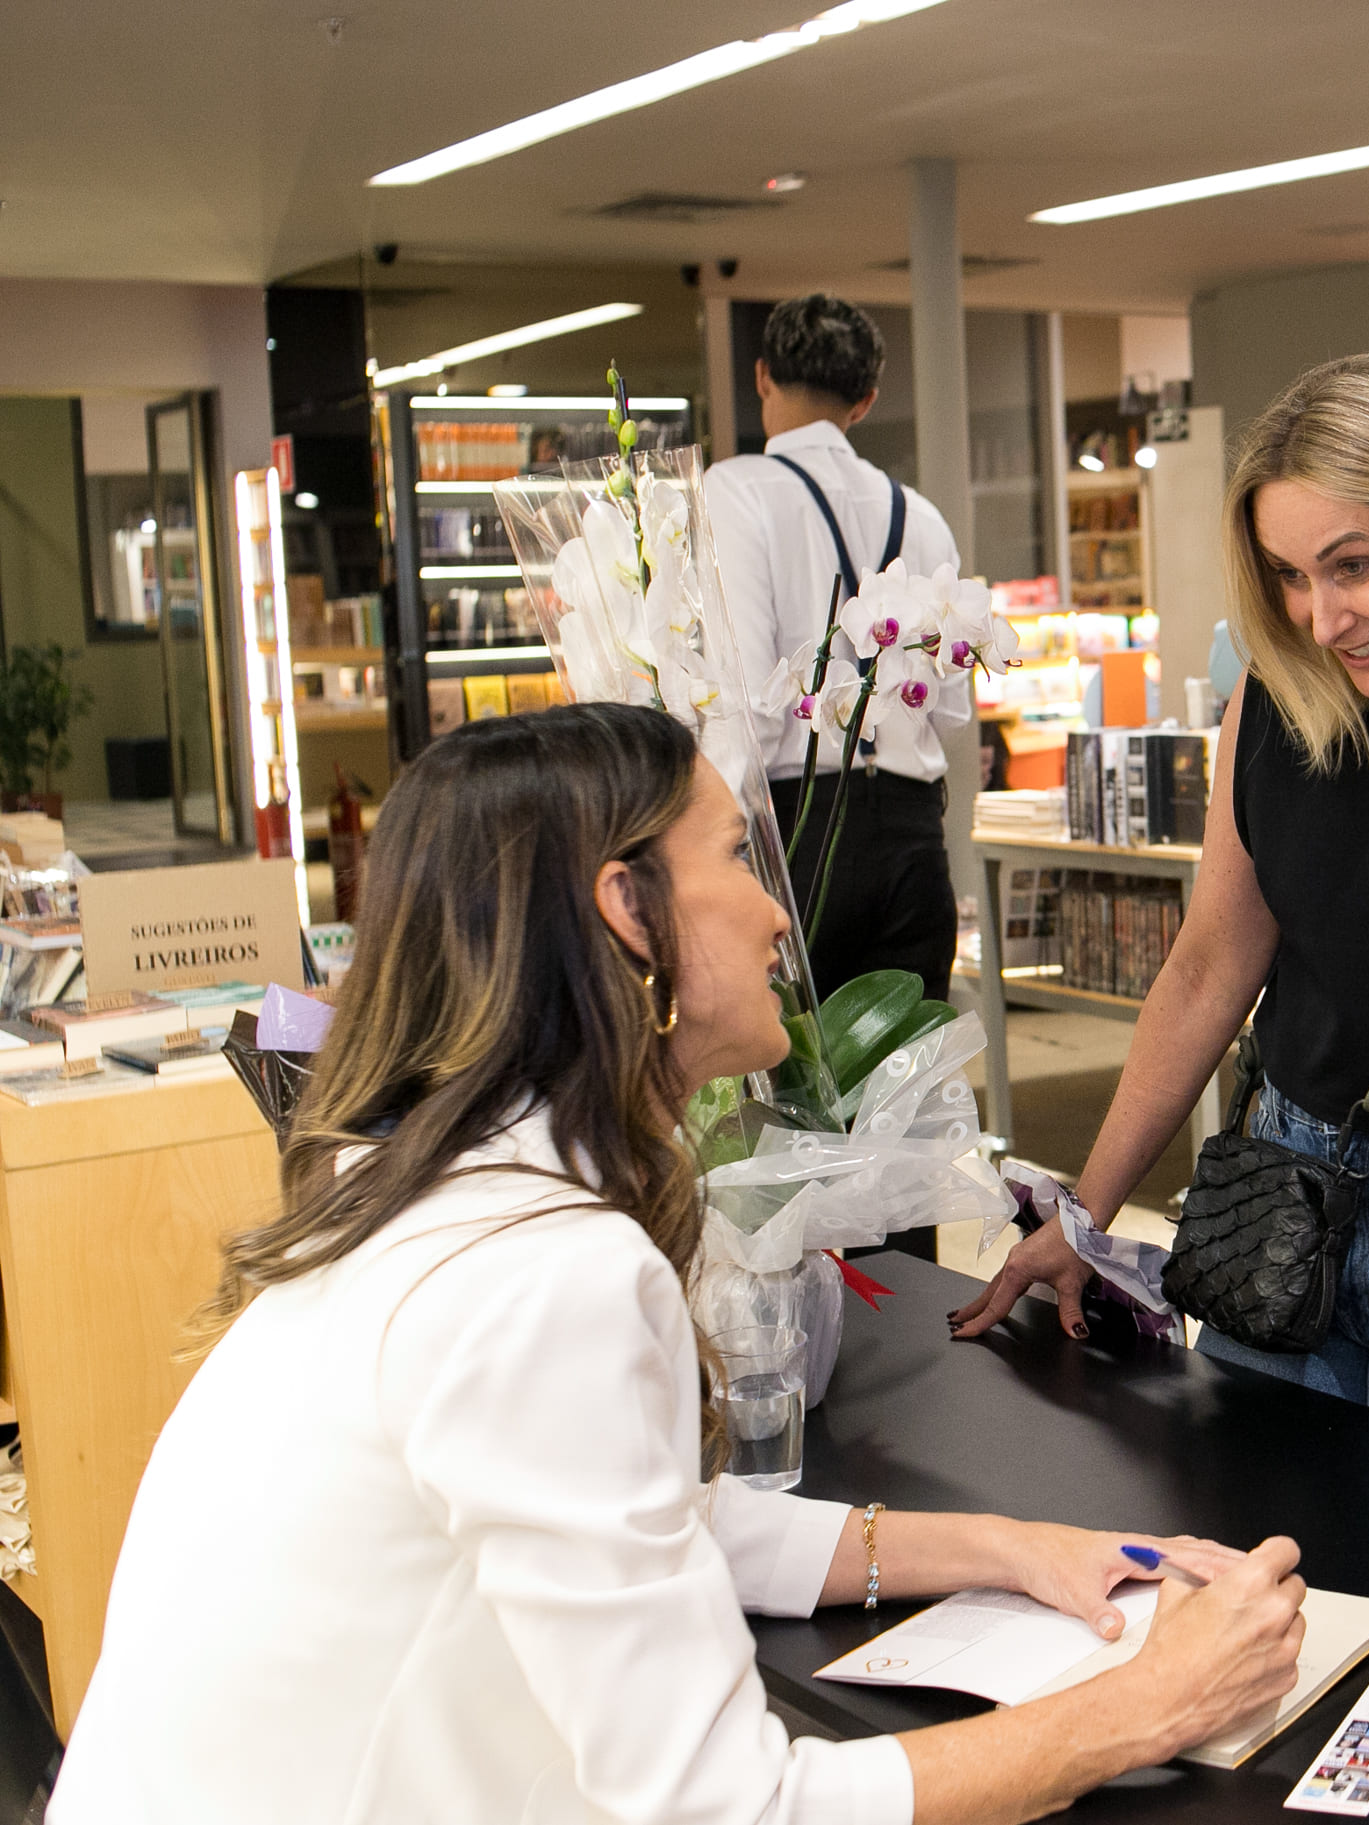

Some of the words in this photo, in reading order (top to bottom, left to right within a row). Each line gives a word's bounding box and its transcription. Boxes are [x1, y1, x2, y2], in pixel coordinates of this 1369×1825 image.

[131, 916, 228, 940] SUGESTÕES
[233, 913, 257, 930] DE
[133, 942, 259, 971] LIVREIROS
